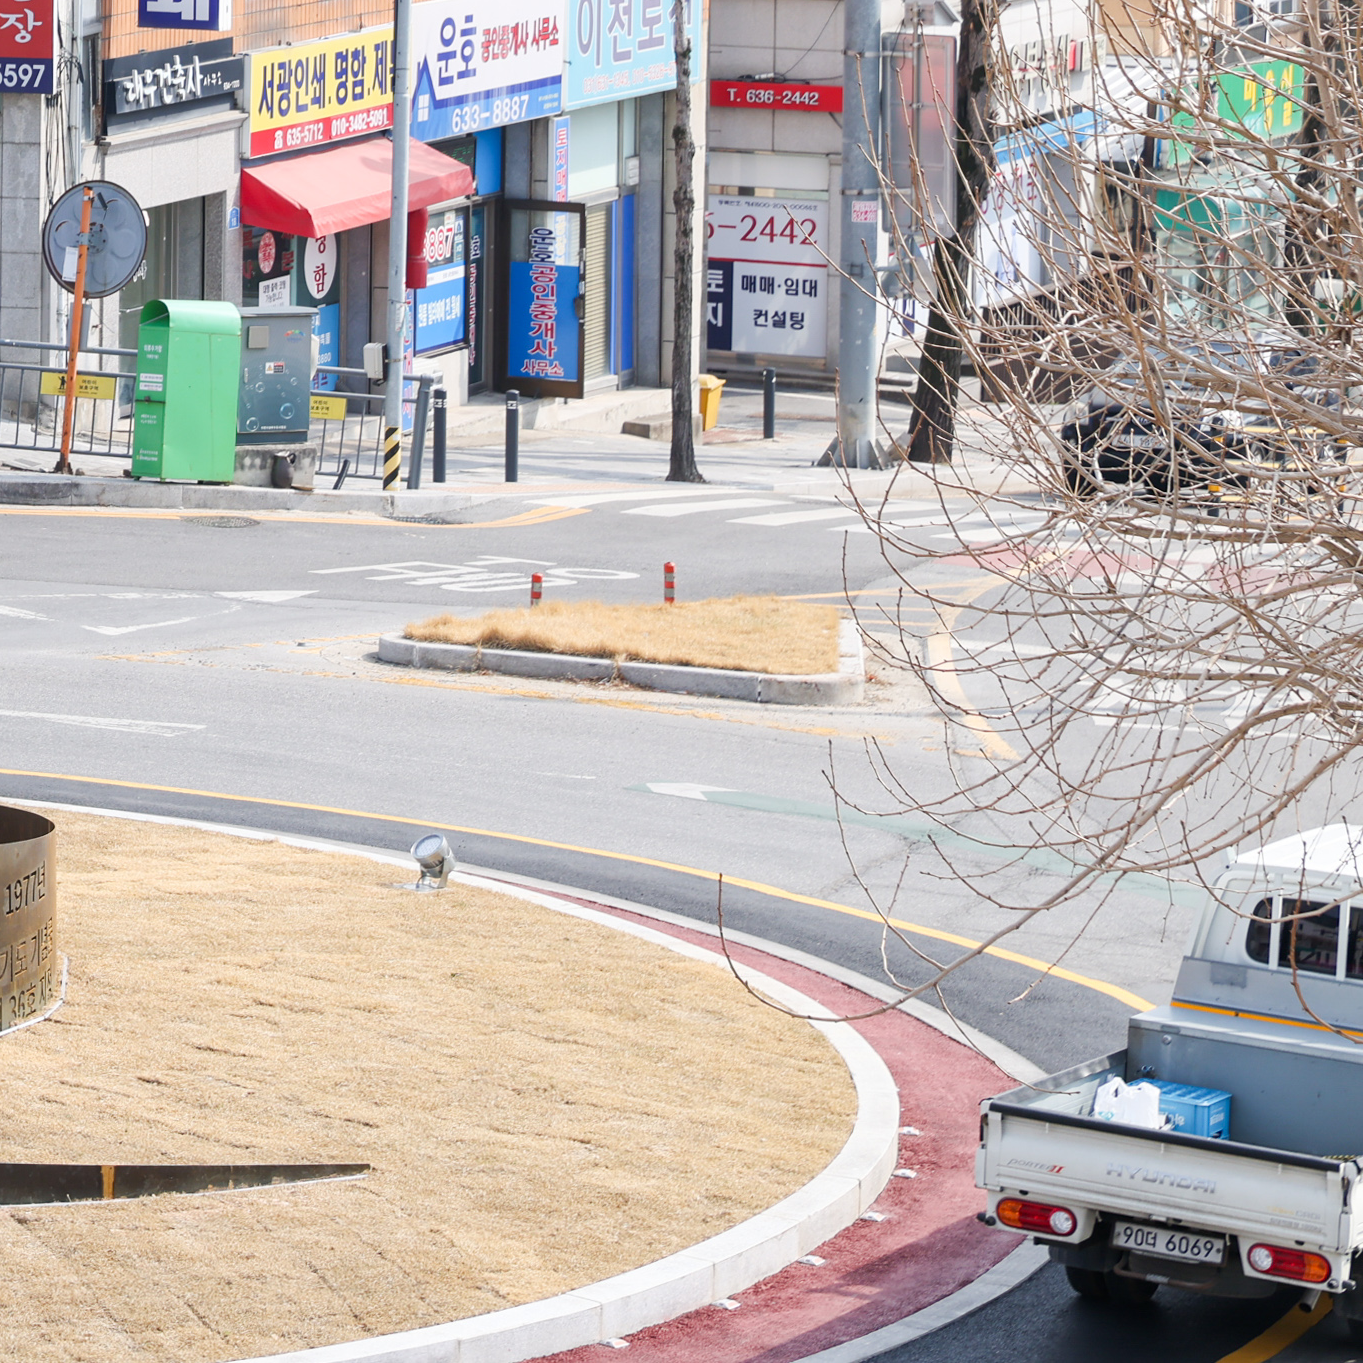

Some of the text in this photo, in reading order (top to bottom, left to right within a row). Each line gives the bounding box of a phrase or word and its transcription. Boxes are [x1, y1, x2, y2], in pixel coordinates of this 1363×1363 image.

[437, 14, 477, 87] 운호
[531, 15, 559, 51] 사무소
[125, 54, 203, 107] 대우건축사
[726, 88, 820, 106] T. 636-2442
[286, 107, 389, 148] 635-5712 010-3482-5091
[451, 94, 530, 133] 633-8887
[529, 226, 556, 264] 운호
[528, 264, 558, 359] 공인중개사
[752, 308, 805, 330] 컨설팅
[521, 359, 564, 378] 사무소
[5, 860, 46, 917] 1977년
[1106, 1161, 1218, 1195] HYUNDAI
[1164, 1230, 1215, 1259] 6069
